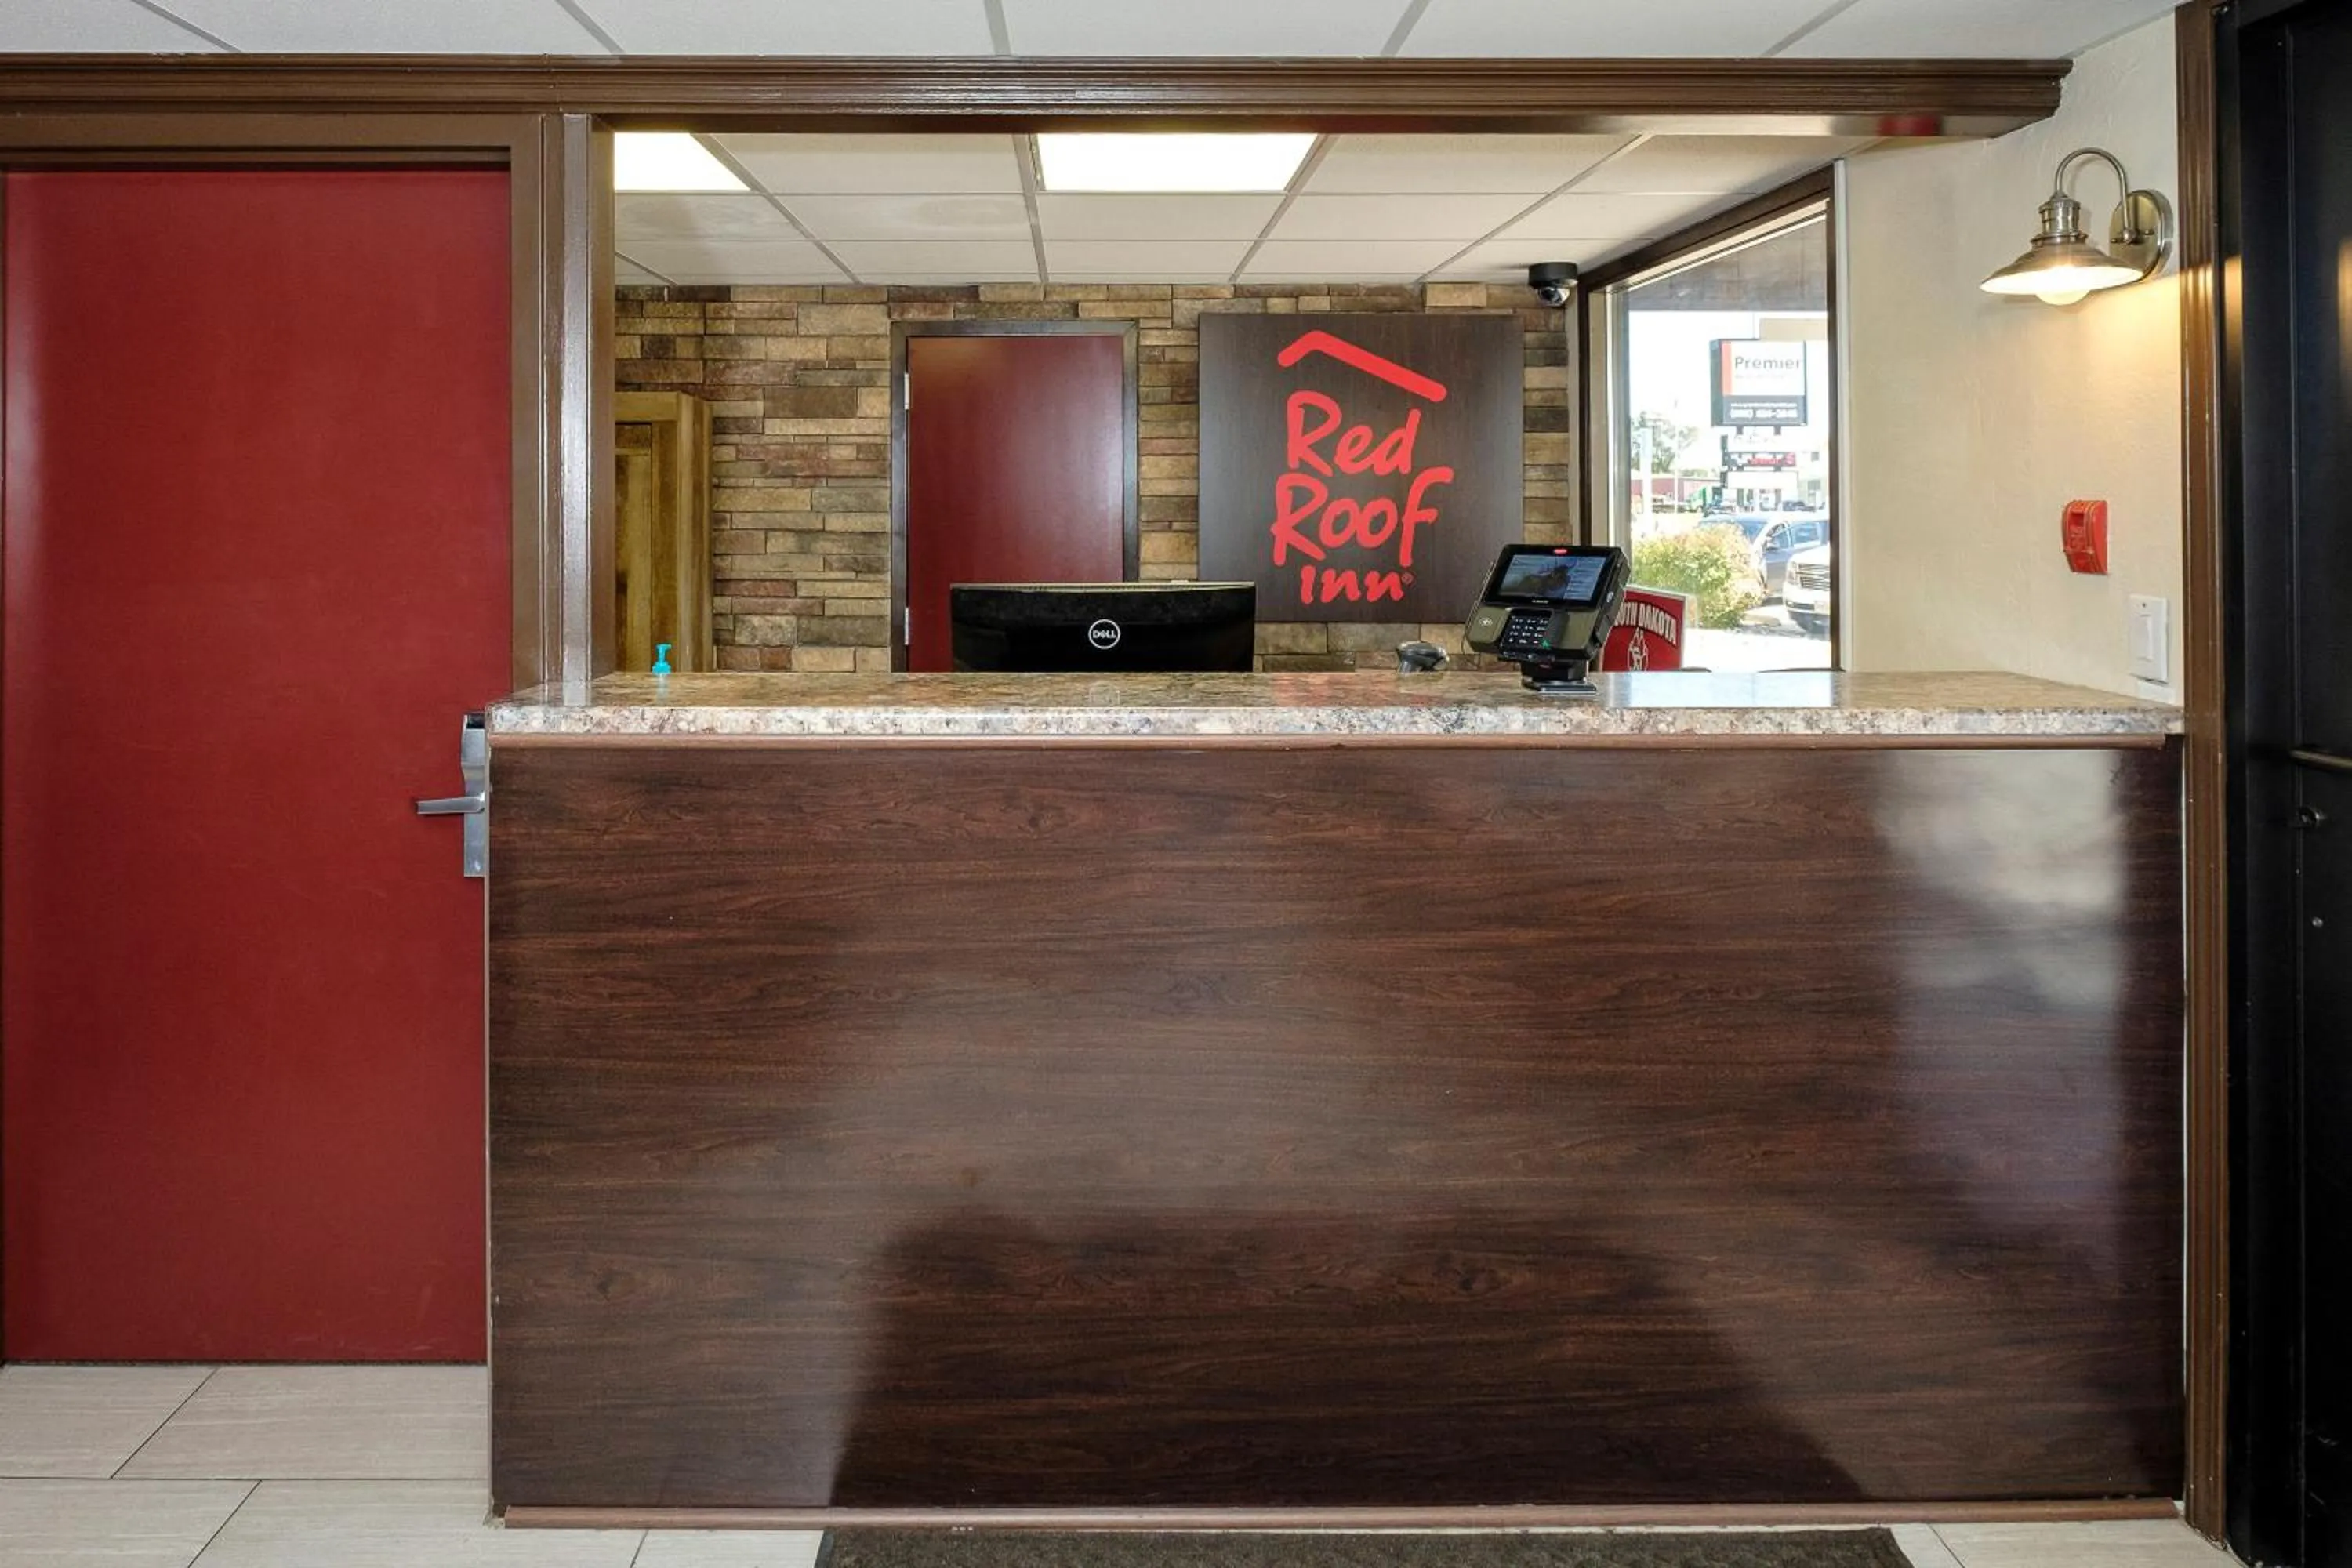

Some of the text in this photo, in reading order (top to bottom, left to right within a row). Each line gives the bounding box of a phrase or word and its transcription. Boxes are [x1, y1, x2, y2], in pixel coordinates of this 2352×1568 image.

[1734, 355, 1800, 370] Premier
[1287, 390, 1421, 477] Red
[1270, 466, 1454, 568] Roof
[1301, 564, 1404, 604] Inn
[1092, 630, 1117, 639] DELL
[1638, 602, 1677, 647] DAKOTA
